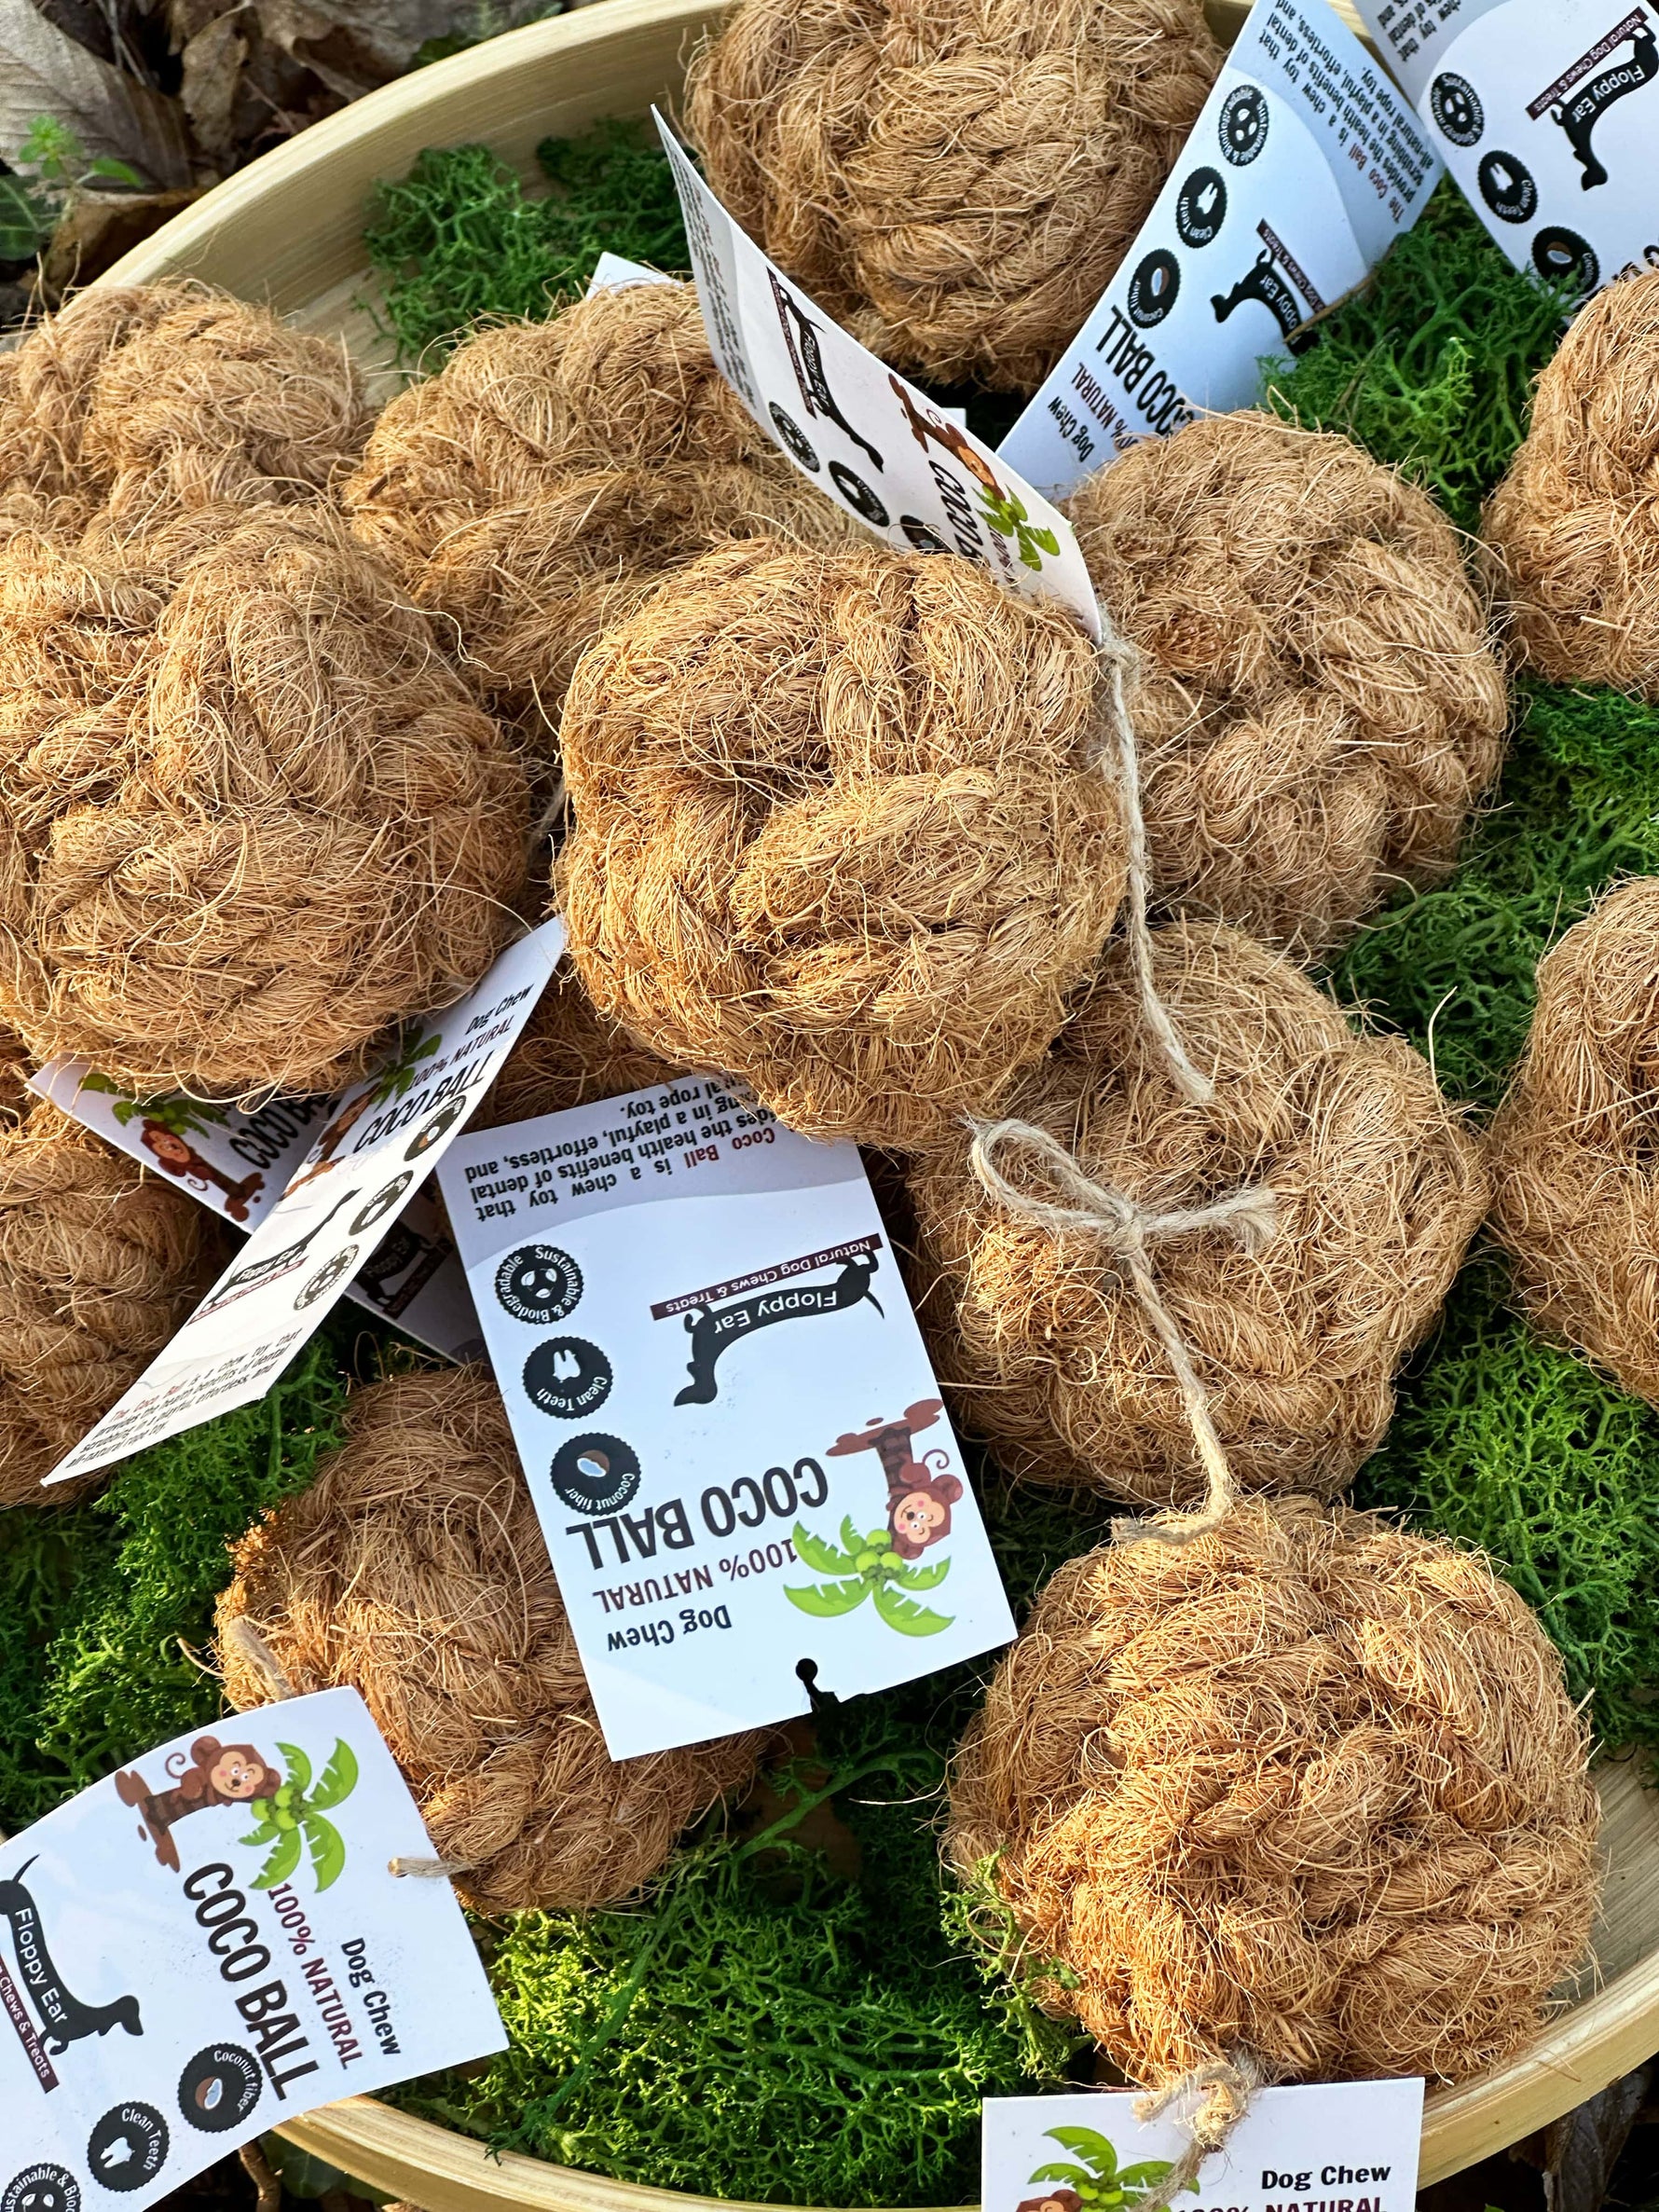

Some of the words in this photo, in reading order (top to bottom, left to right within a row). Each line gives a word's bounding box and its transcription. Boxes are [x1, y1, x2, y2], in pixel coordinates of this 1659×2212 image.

[1275, 0, 1296, 21] and
[1258, 29, 1281, 60] that
[1267, 12, 1298, 51] dental
[1297, 14, 1342, 76] effortless,
[1610, 14, 1641, 48] Natural
[1296, 48, 1309, 64] of
[1589, 42, 1611, 60] Dog
[1282, 57, 1300, 84] toy
[1361, 66, 1378, 94] toy.
[1558, 79, 1569, 89] &
[1566, 59, 1593, 83] Chews
[1592, 65, 1646, 101] Floppy
[1302, 82, 1326, 114] chew
[1309, 61, 1345, 112] benefits
[1341, 69, 1375, 115] playful,
[1533, 86, 1562, 111] Treats
[1375, 89, 1397, 117] rope
[1571, 97, 1596, 123] Ear
[1328, 115, 1337, 127] a
[1343, 104, 1371, 145] health
[1371, 112, 1379, 124] a
[1378, 120, 1390, 140] in
[1338, 127, 1349, 146] is
[1369, 138, 1384, 163] the
[1392, 113, 1433, 170] all-natural
[1348, 143, 1367, 171] Ball
[1386, 130, 1424, 186] scrubbing
[1368, 168, 1388, 199] Coco
[1383, 157, 1417, 203] provides
[1389, 197, 1405, 224] The
[1259, 274, 1280, 300] Ear
[1095, 304, 1156, 394] BALL
[803, 330, 819, 382] Floppy
[813, 378, 830, 408] Ear
[1071, 363, 1118, 430] NATURAL
[1048, 396, 1077, 439] Chew
[1073, 425, 1095, 462] Dog
[928, 460, 983, 546] COCO
[465, 1007, 497, 1036] Dog
[495, 983, 535, 1016] Chew
[406, 1055, 450, 1092] 100%
[449, 1015, 514, 1066] NATURAL
[353, 1089, 431, 1154] COCO
[420, 1050, 495, 1117] BALL
[620, 1100, 656, 1120] toy.
[659, 1086, 702, 1108] rope
[692, 1104, 713, 1117] in
[602, 1113, 671, 1147] playful,
[676, 1111, 687, 1124] a
[701, 1120, 734, 1139] the
[229, 1107, 298, 1169] COCO
[638, 1130, 698, 1158] health
[732, 1127, 775, 1150] Coco
[503, 1136, 598, 1169] effortless,
[557, 1148, 635, 1180] benefits
[653, 1158, 673, 1175] is
[683, 1144, 720, 1169] Ball
[465, 1161, 500, 1184] and
[535, 1169, 553, 1188] of
[571, 1174, 617, 1197] chew
[630, 1167, 642, 1180] a
[471, 1175, 529, 1203] dental
[529, 1189, 558, 1207] toy
[475, 1200, 516, 1222] that
[781, 1258, 811, 1275] Dog
[816, 1240, 871, 1267] Natural
[497, 1255, 551, 1324] Biodegradable
[535, 1246, 581, 1307] Sustainable
[731, 1270, 778, 1292] Chews
[665, 1295, 714, 1313] Treats
[716, 1285, 728, 1298] &
[758, 1291, 838, 1317] Floppy
[552, 1304, 565, 1317] &
[714, 1310, 751, 1334] Ear
[537, 1388, 574, 1411] Teeth
[577, 1375, 608, 1406] Clean
[565, 1486, 593, 1510] fiber
[596, 1472, 636, 1510] Coconut
[701, 1457, 829, 1538] COCO
[565, 1498, 695, 1571] BALL
[719, 1538, 798, 1581] 100%
[592, 1564, 714, 1614] NATURAL
[679, 1604, 733, 1635] Dog
[608, 1620, 676, 1652] Chew
[15, 1907, 48, 1985] Floppy
[41, 1986, 68, 2023] Ear
[267, 1883, 316, 1956] 100%
[301, 1958, 363, 2070] NATURAL
[183, 1862, 271, 1983] COCO
[235, 1979, 320, 2102] BALL
[341, 1937, 376, 1988] Dog
[363, 1990, 402, 2055] Chew
[0, 1976, 23, 2021] Chews
[19, 2021, 31, 2034] &
[25, 2036, 50, 2079] Treats
[213, 2050, 256, 2081] Coconut
[236, 2081, 259, 2113] fiber
[121, 2108, 154, 2132] Clean
[142, 2129, 162, 2171] Teeth
[4, 2165, 58, 2212] ustainable
[57, 2173, 70, 2187] &
[1261, 2169, 1312, 2191] Dog
[1321, 2165, 1392, 2186] Chew
[1265, 2196, 1388, 2212] NATURAL
